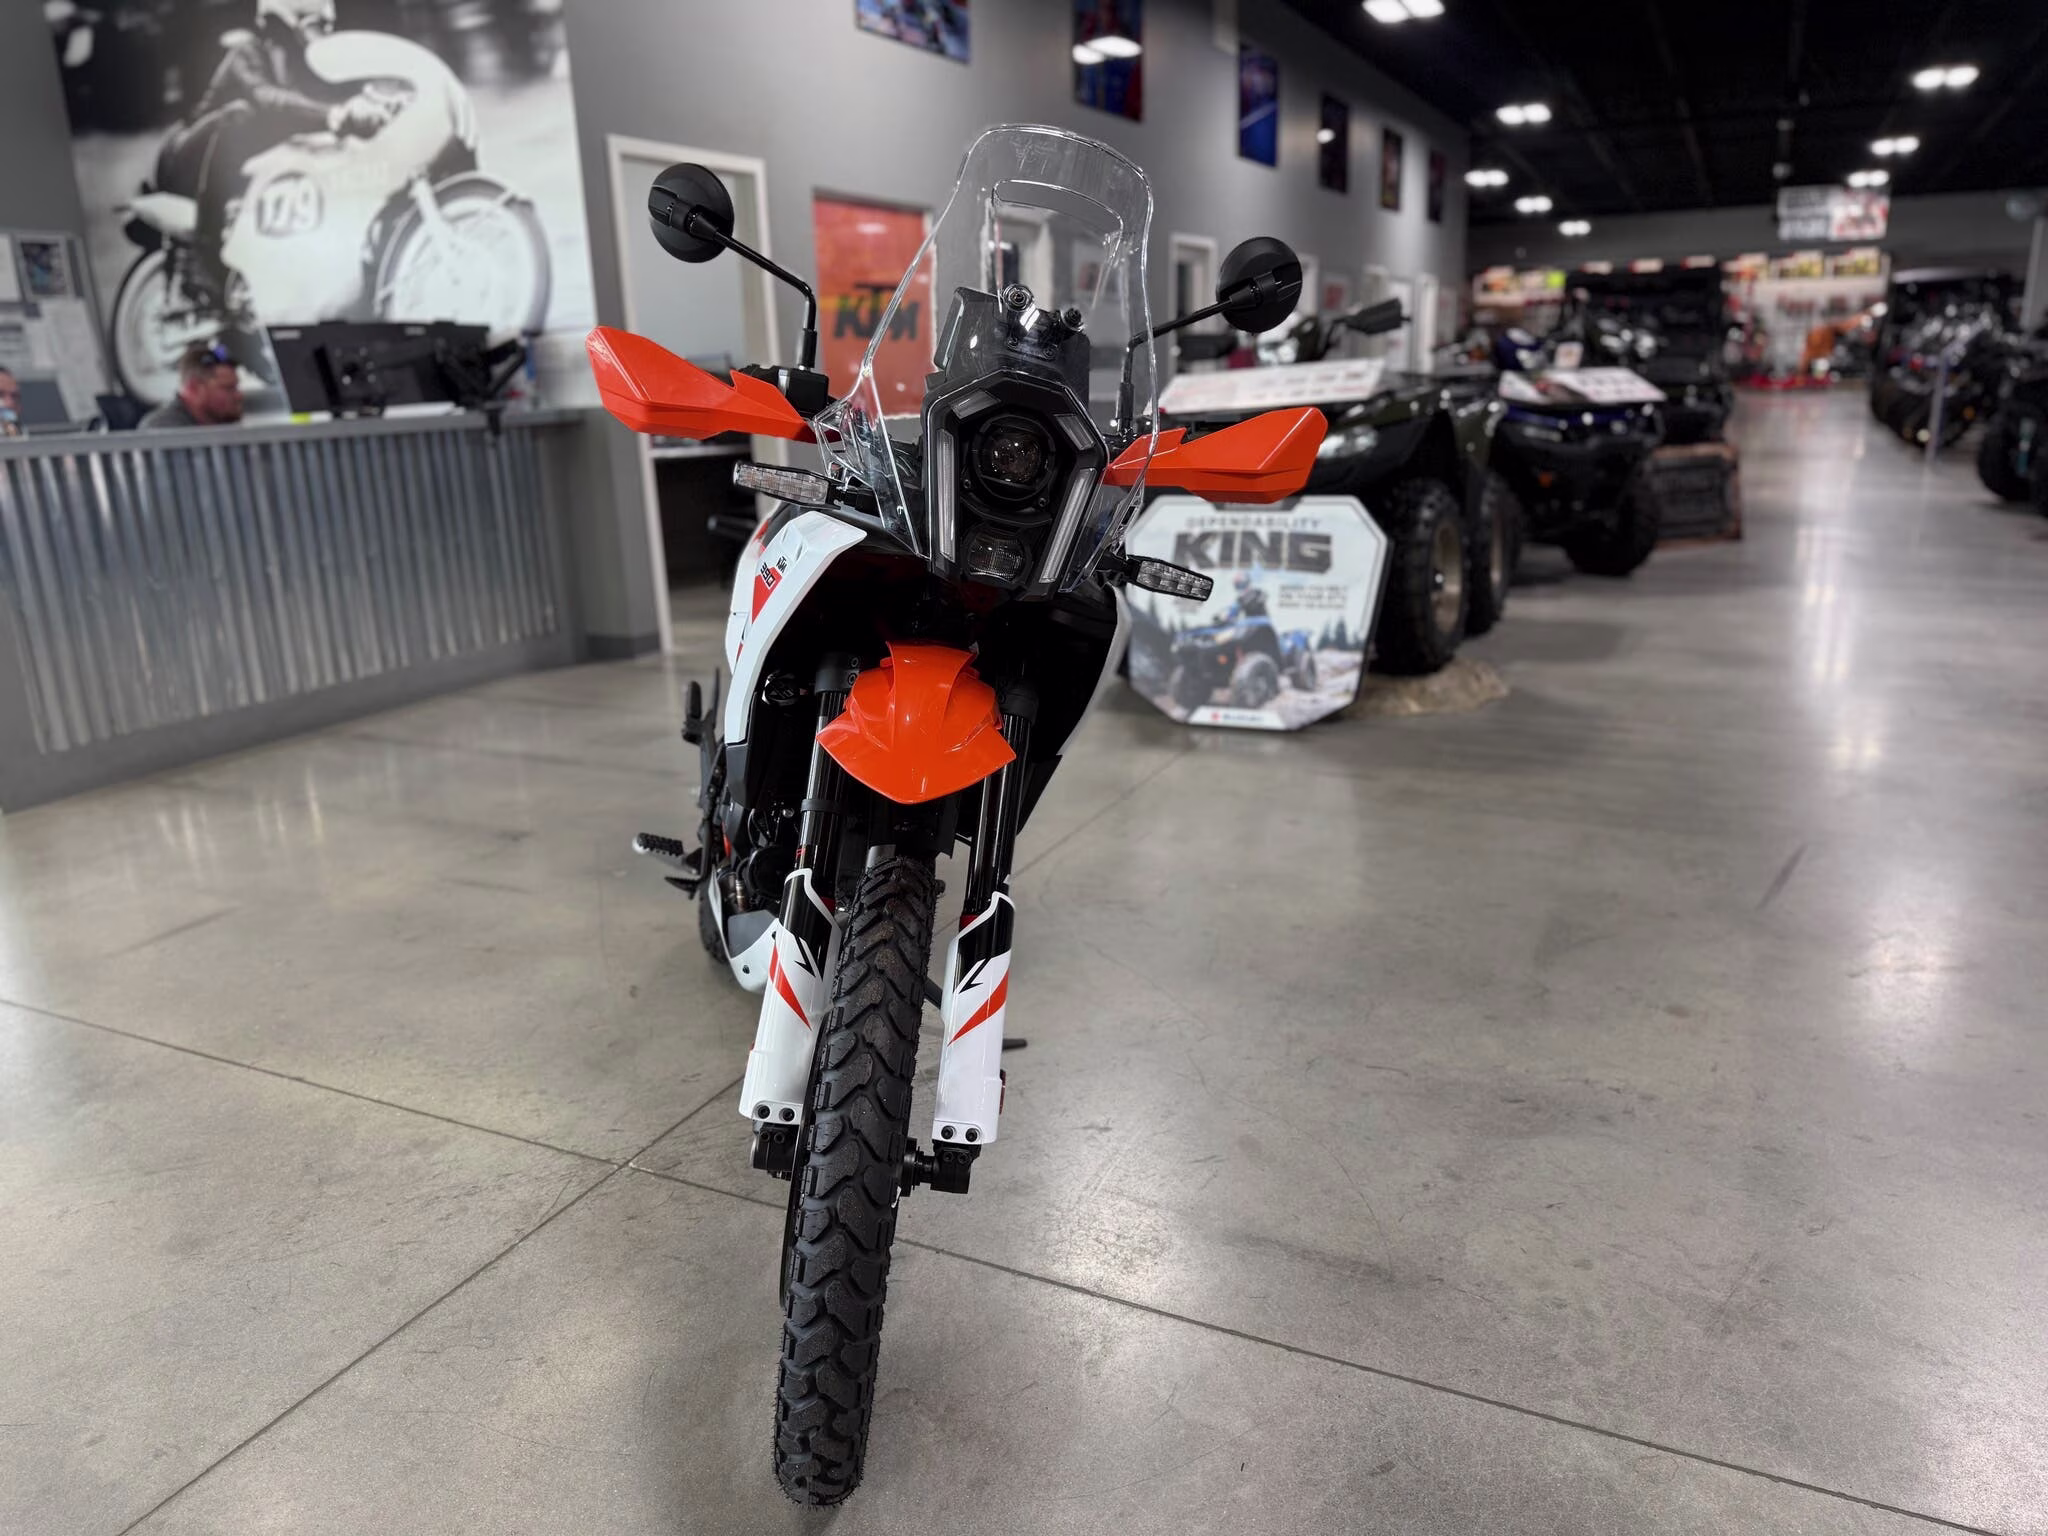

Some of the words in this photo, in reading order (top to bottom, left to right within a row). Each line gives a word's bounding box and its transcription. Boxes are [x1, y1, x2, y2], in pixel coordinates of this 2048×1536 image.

[834, 283, 919, 340] KTM
[776, 555, 788, 573] KTM
[1173, 531, 1333, 574] KING
[760, 562, 776, 587] 390
